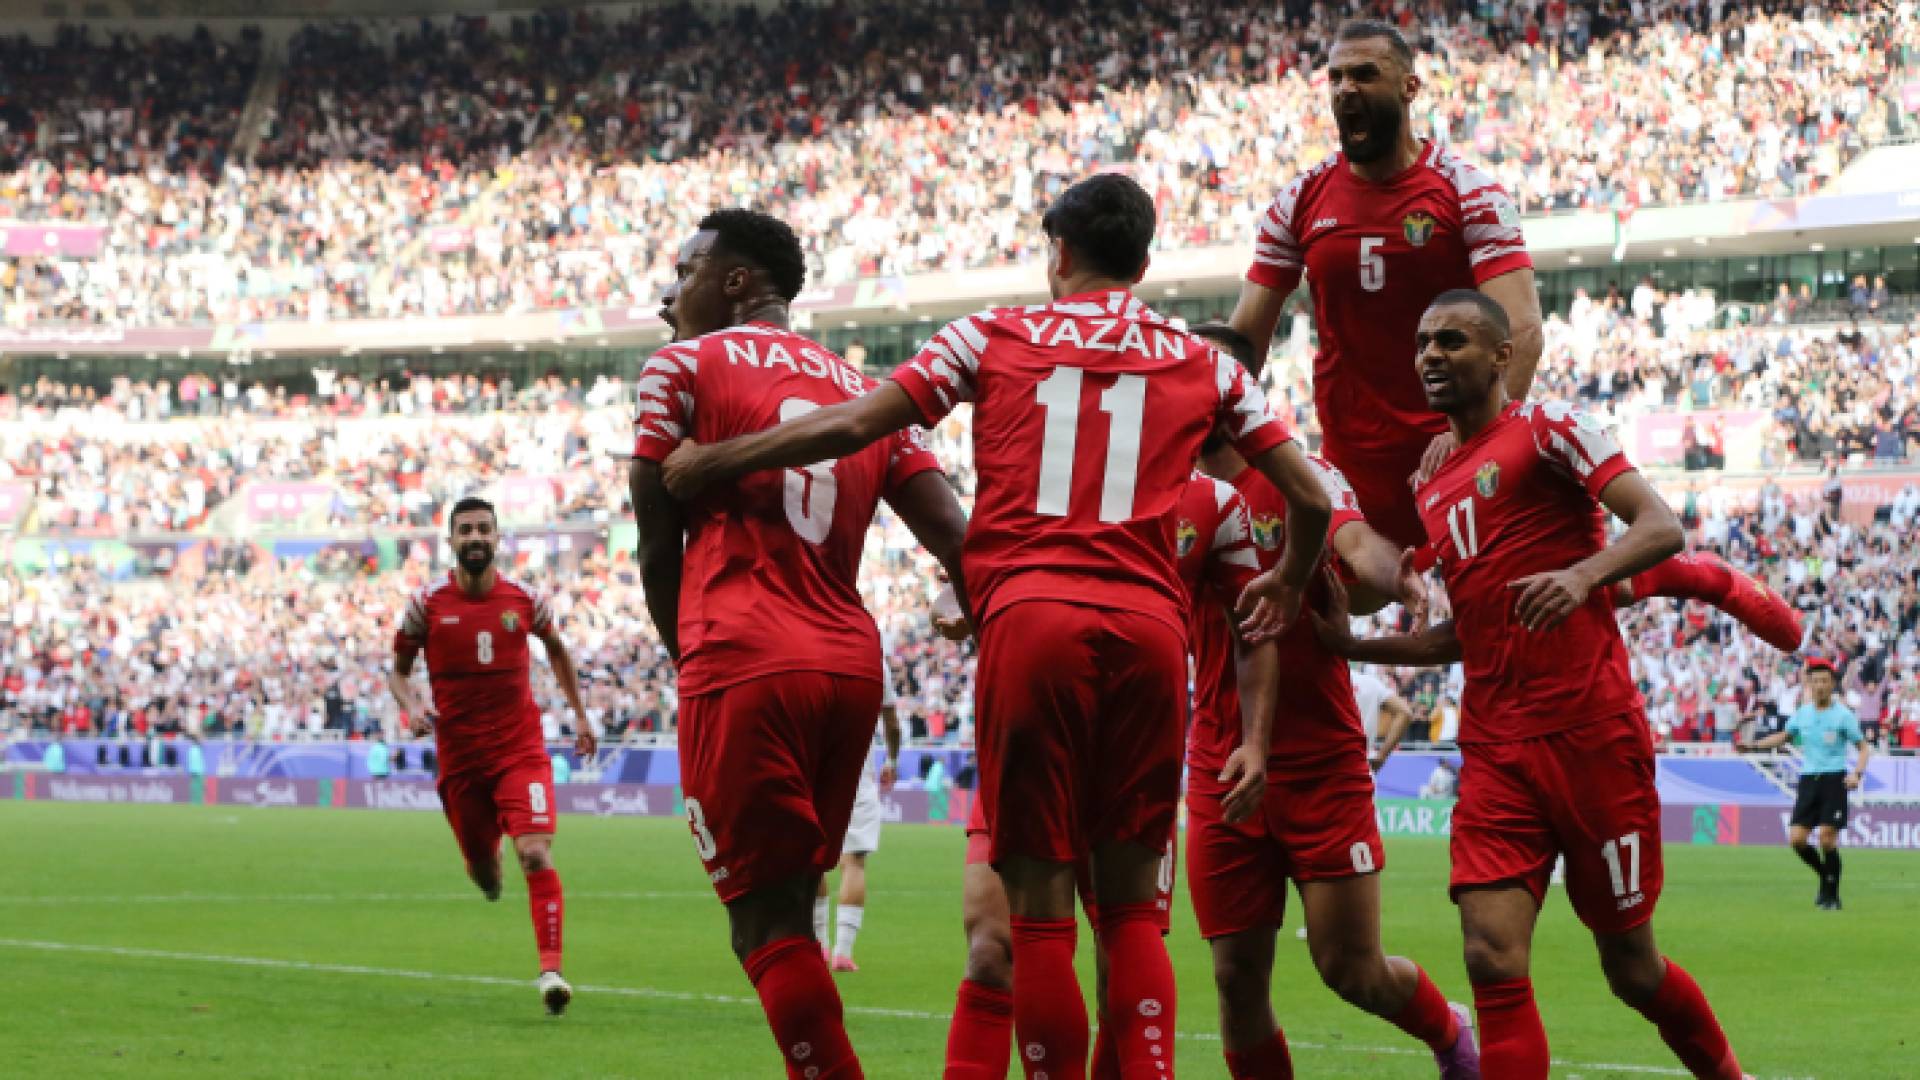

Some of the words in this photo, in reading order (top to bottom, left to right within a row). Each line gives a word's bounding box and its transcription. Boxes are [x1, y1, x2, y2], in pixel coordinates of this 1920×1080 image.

[1360, 236, 1385, 291] 5
[1021, 317, 1187, 360] YAZAN
[1035, 366, 1147, 523] 11
[1446, 496, 1477, 560] 17
[477, 630, 493, 665] 8
[529, 782, 546, 813] 8
[1374, 806, 1435, 833] ATAR
[686, 797, 716, 861] 3
[1601, 832, 1640, 896] 17
